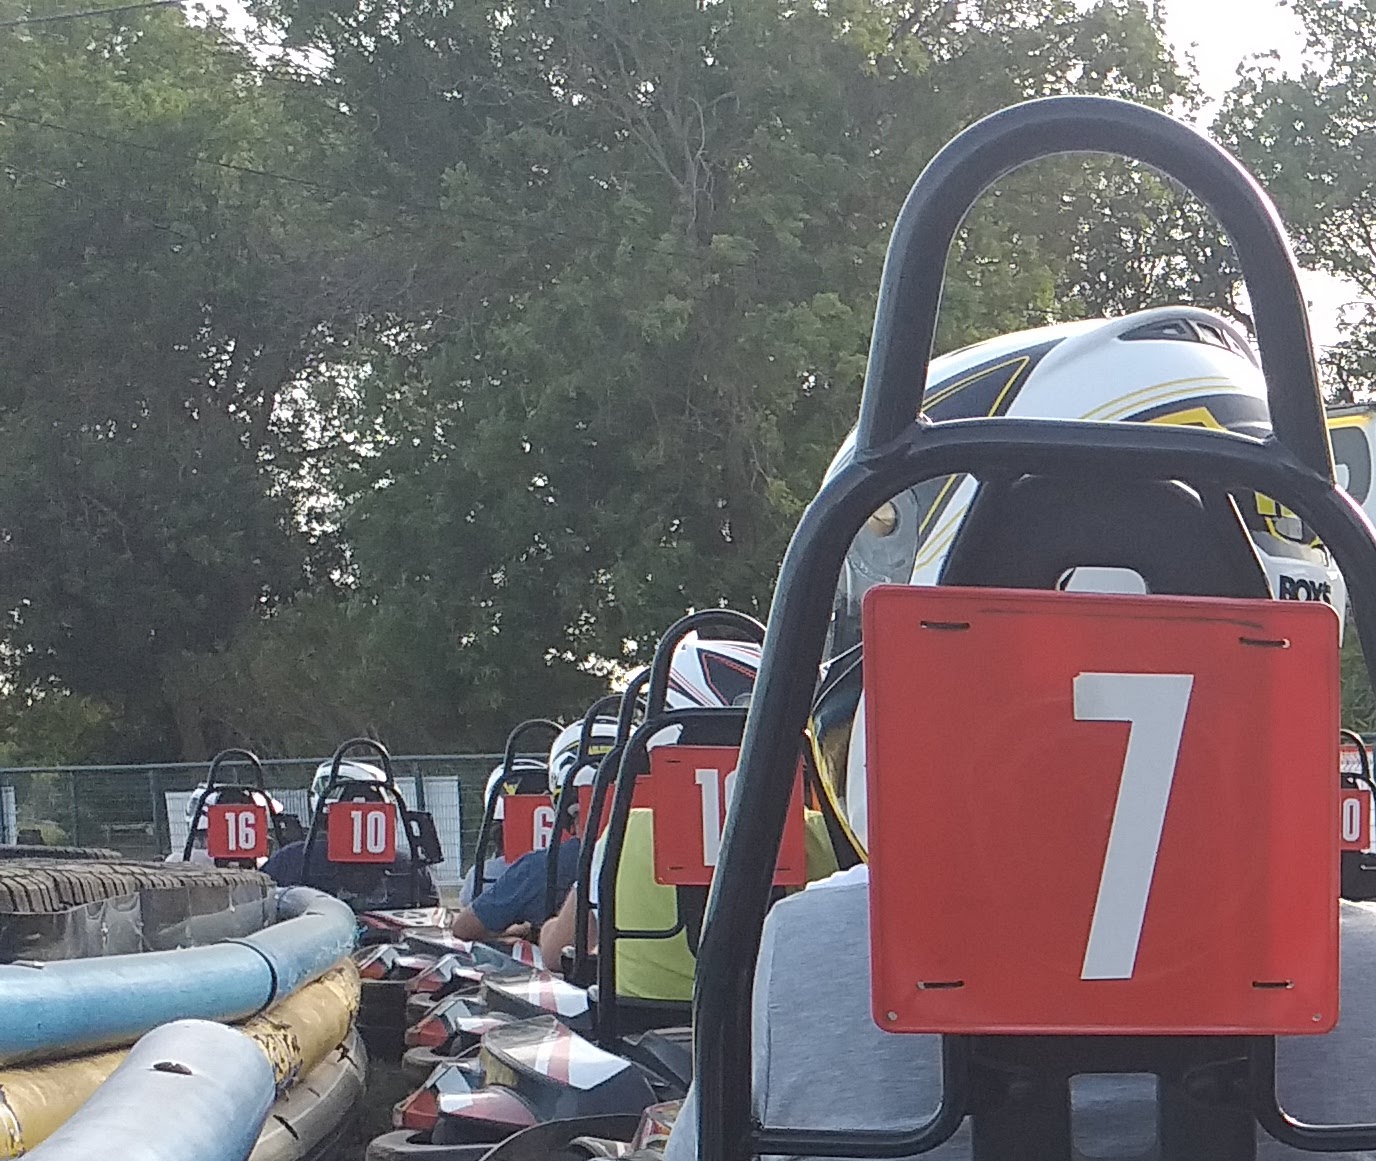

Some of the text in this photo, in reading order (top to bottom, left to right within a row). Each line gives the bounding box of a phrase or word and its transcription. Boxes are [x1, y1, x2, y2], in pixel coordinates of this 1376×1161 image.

[224, 811, 256, 850] 16
[351, 810, 386, 854] 10
[532, 806, 554, 850] 6
[694, 768, 739, 866] 1
[1073, 672, 1194, 979] 7
